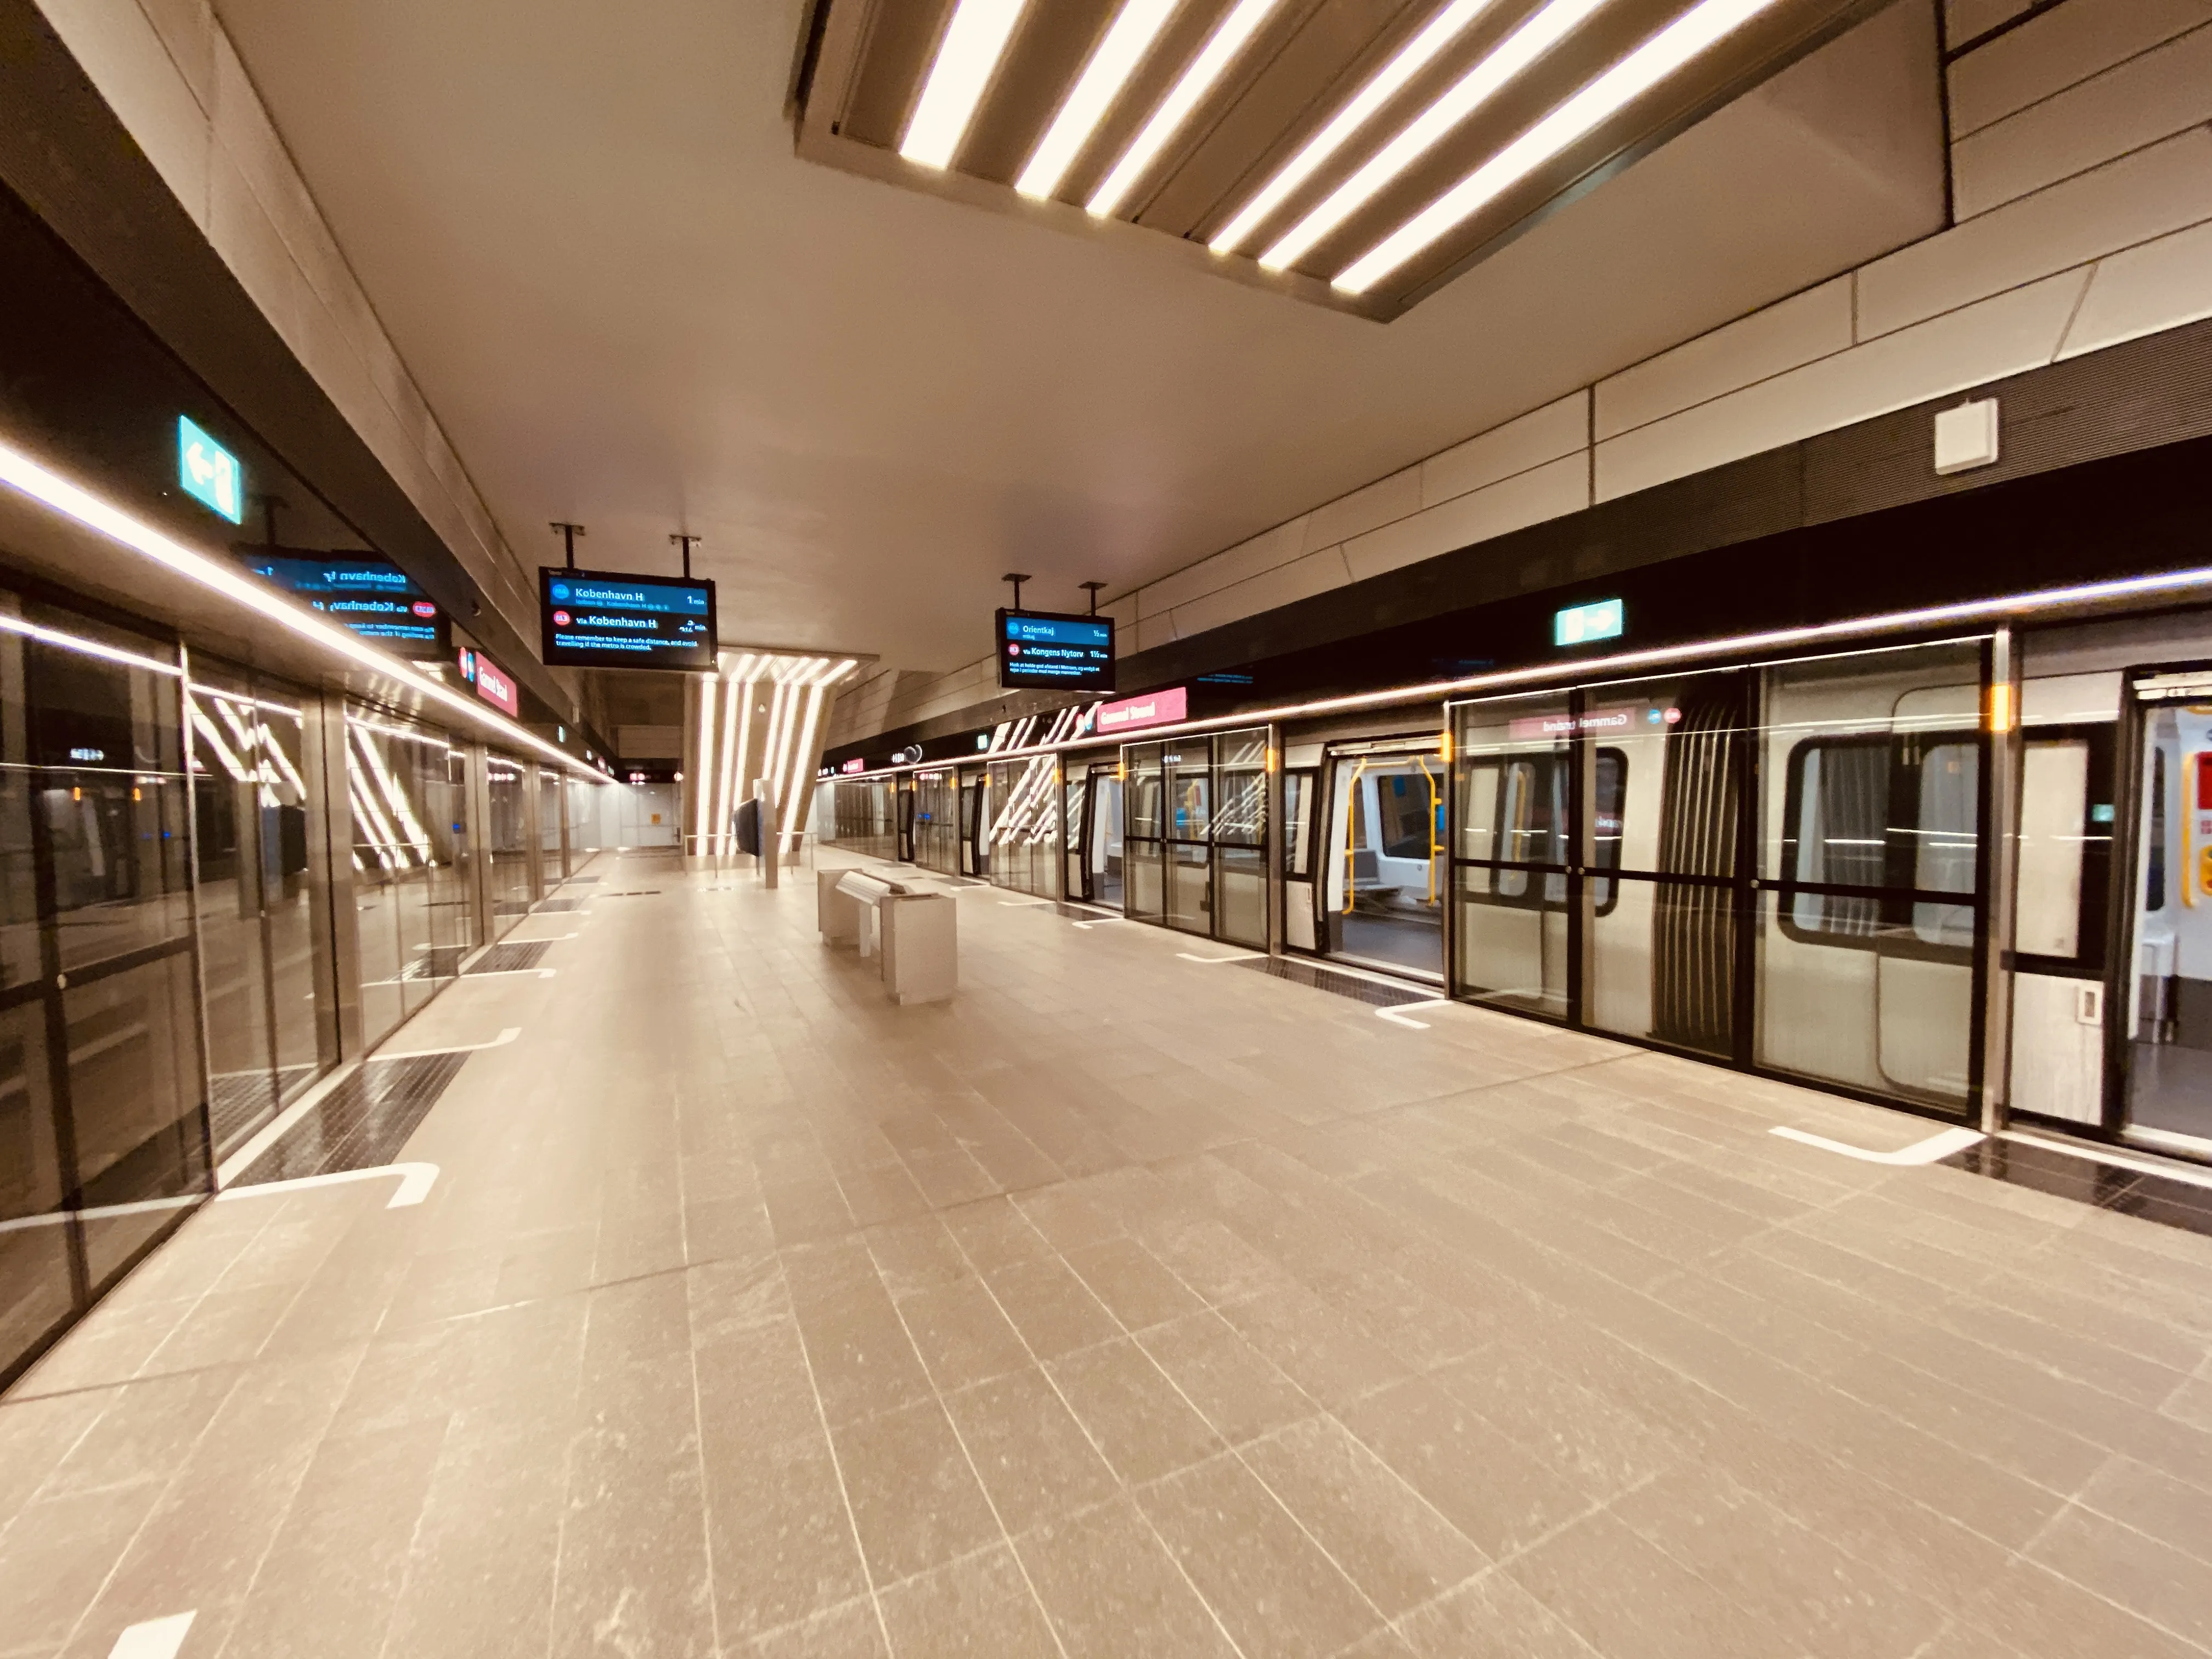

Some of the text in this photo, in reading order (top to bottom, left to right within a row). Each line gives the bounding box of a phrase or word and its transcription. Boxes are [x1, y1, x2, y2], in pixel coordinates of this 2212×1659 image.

[635, 592, 644, 601] H
[687, 596, 692, 604] 1
[648, 619, 657, 628] H
[1023, 625, 1054, 636] Orientkaj
[1031, 648, 1060, 657] Kongens
[1061, 650, 1084, 658] Nytorv
